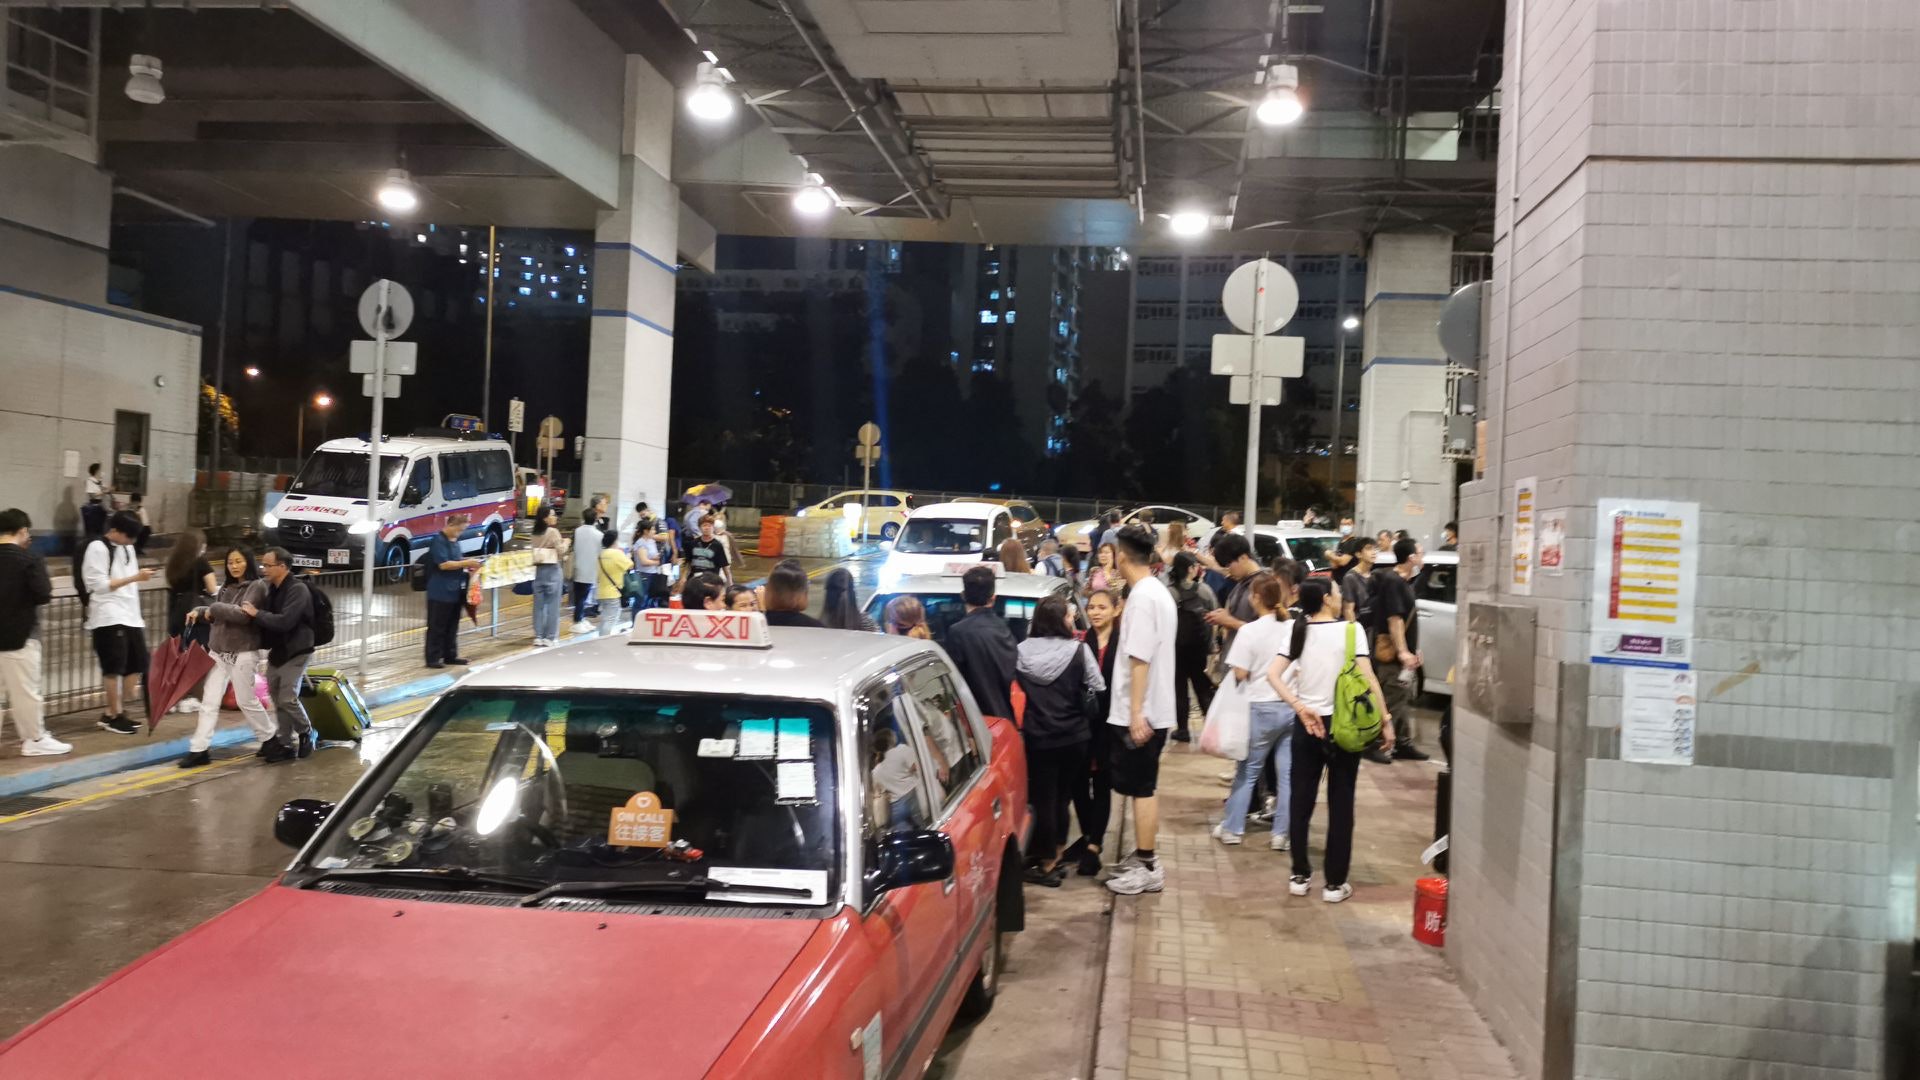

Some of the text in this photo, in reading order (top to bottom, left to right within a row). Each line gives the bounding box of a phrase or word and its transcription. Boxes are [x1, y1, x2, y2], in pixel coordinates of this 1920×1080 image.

[645, 613, 749, 640] TAXI
[617, 811, 665, 824] ON CALL
[615, 824, 665, 841] 往接客
